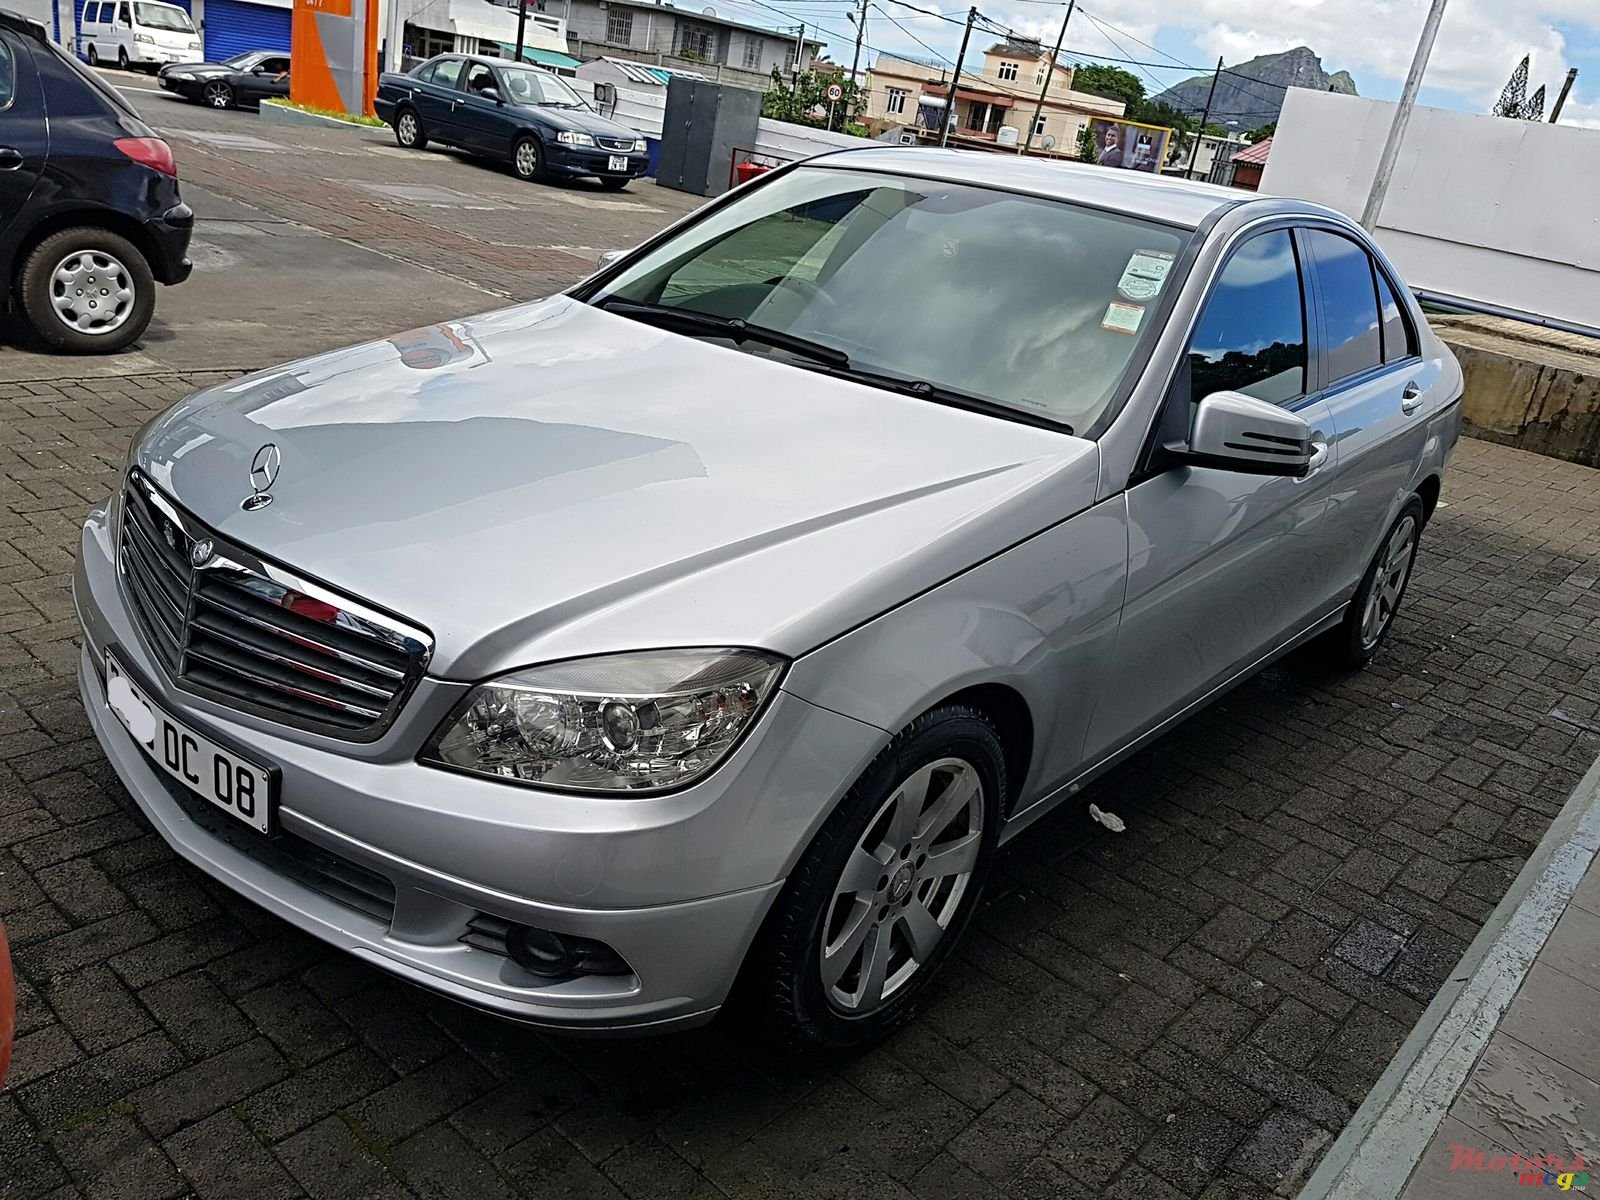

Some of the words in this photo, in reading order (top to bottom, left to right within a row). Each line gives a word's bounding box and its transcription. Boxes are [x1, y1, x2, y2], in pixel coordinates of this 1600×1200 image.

[829, 87, 840, 97] 60
[163, 719, 199, 785] DC
[213, 753, 255, 818] 08
